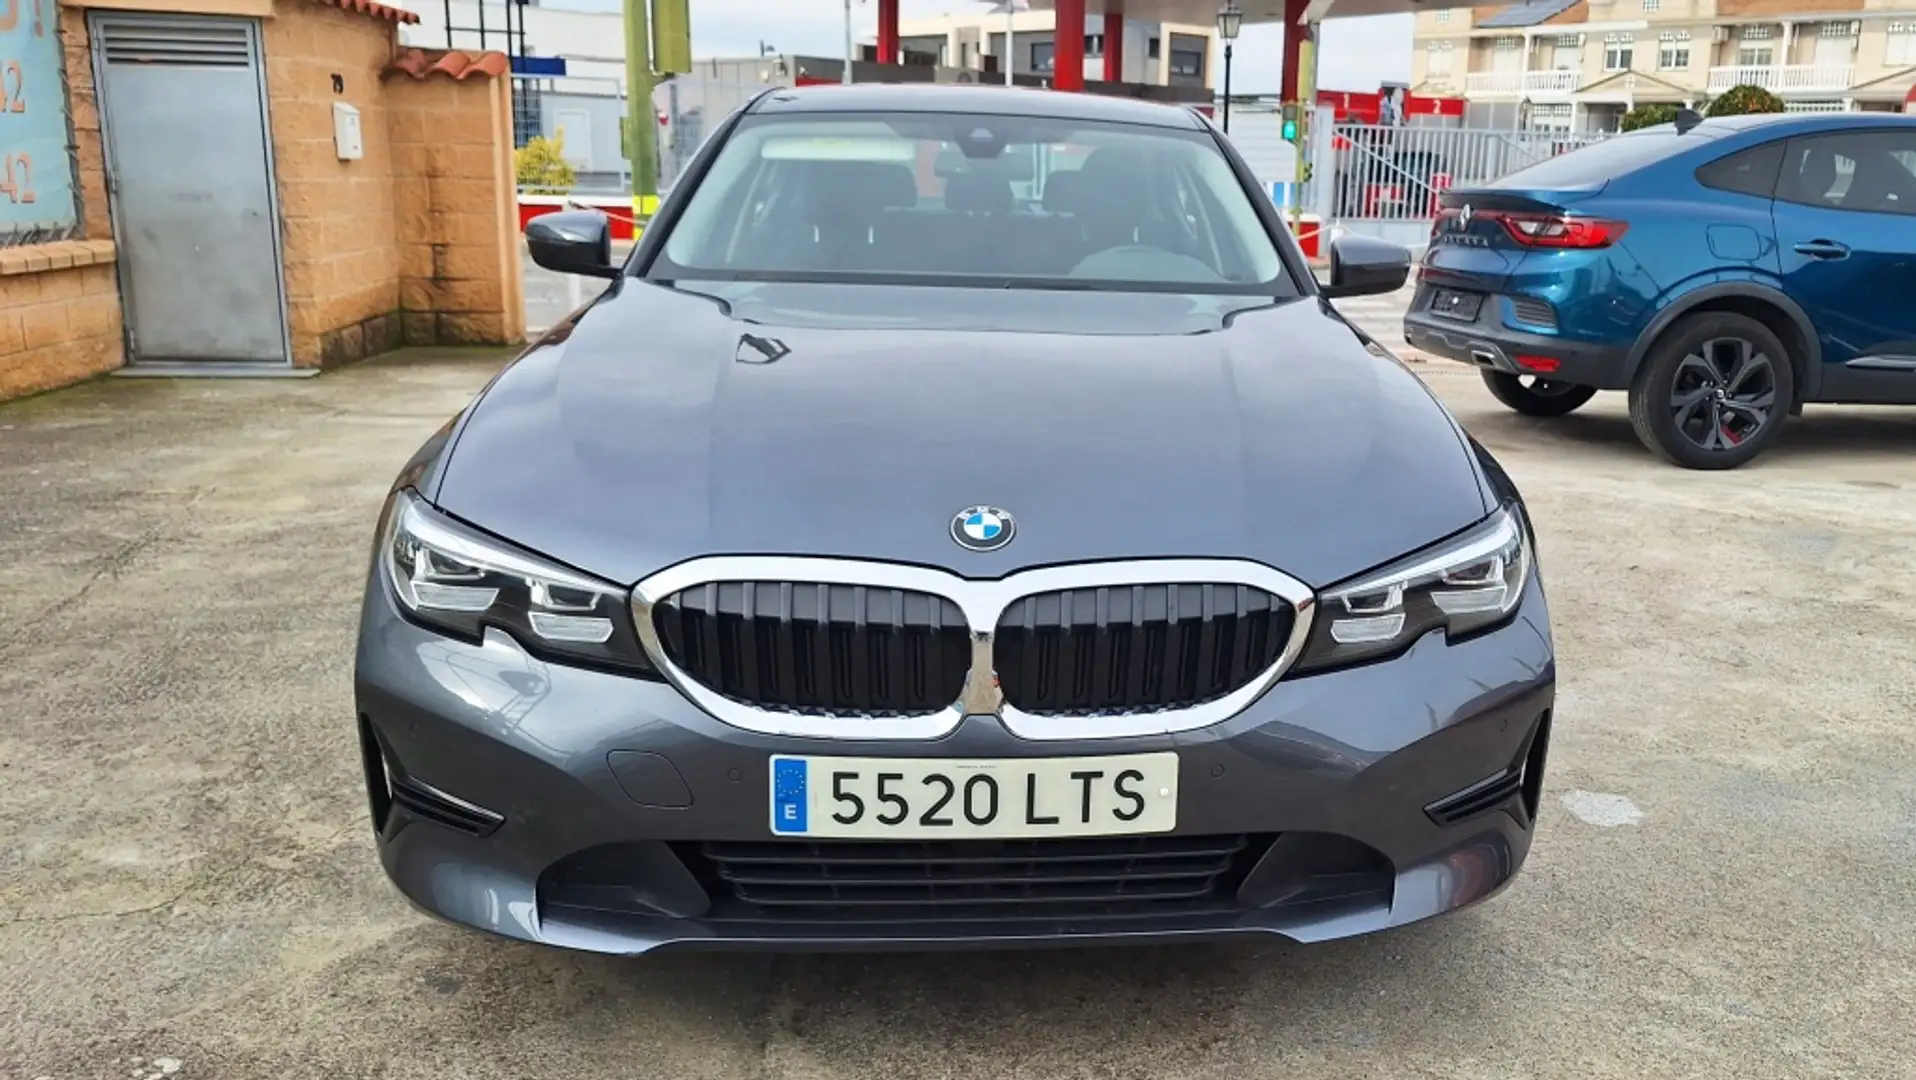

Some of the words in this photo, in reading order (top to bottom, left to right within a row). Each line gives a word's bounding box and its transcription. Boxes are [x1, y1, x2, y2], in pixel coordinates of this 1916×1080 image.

[1433, 99, 1442, 114] 2
[832, 771, 998, 826] 5520
[1026, 769, 1145, 825] LTS
[784, 804, 797, 820] E
